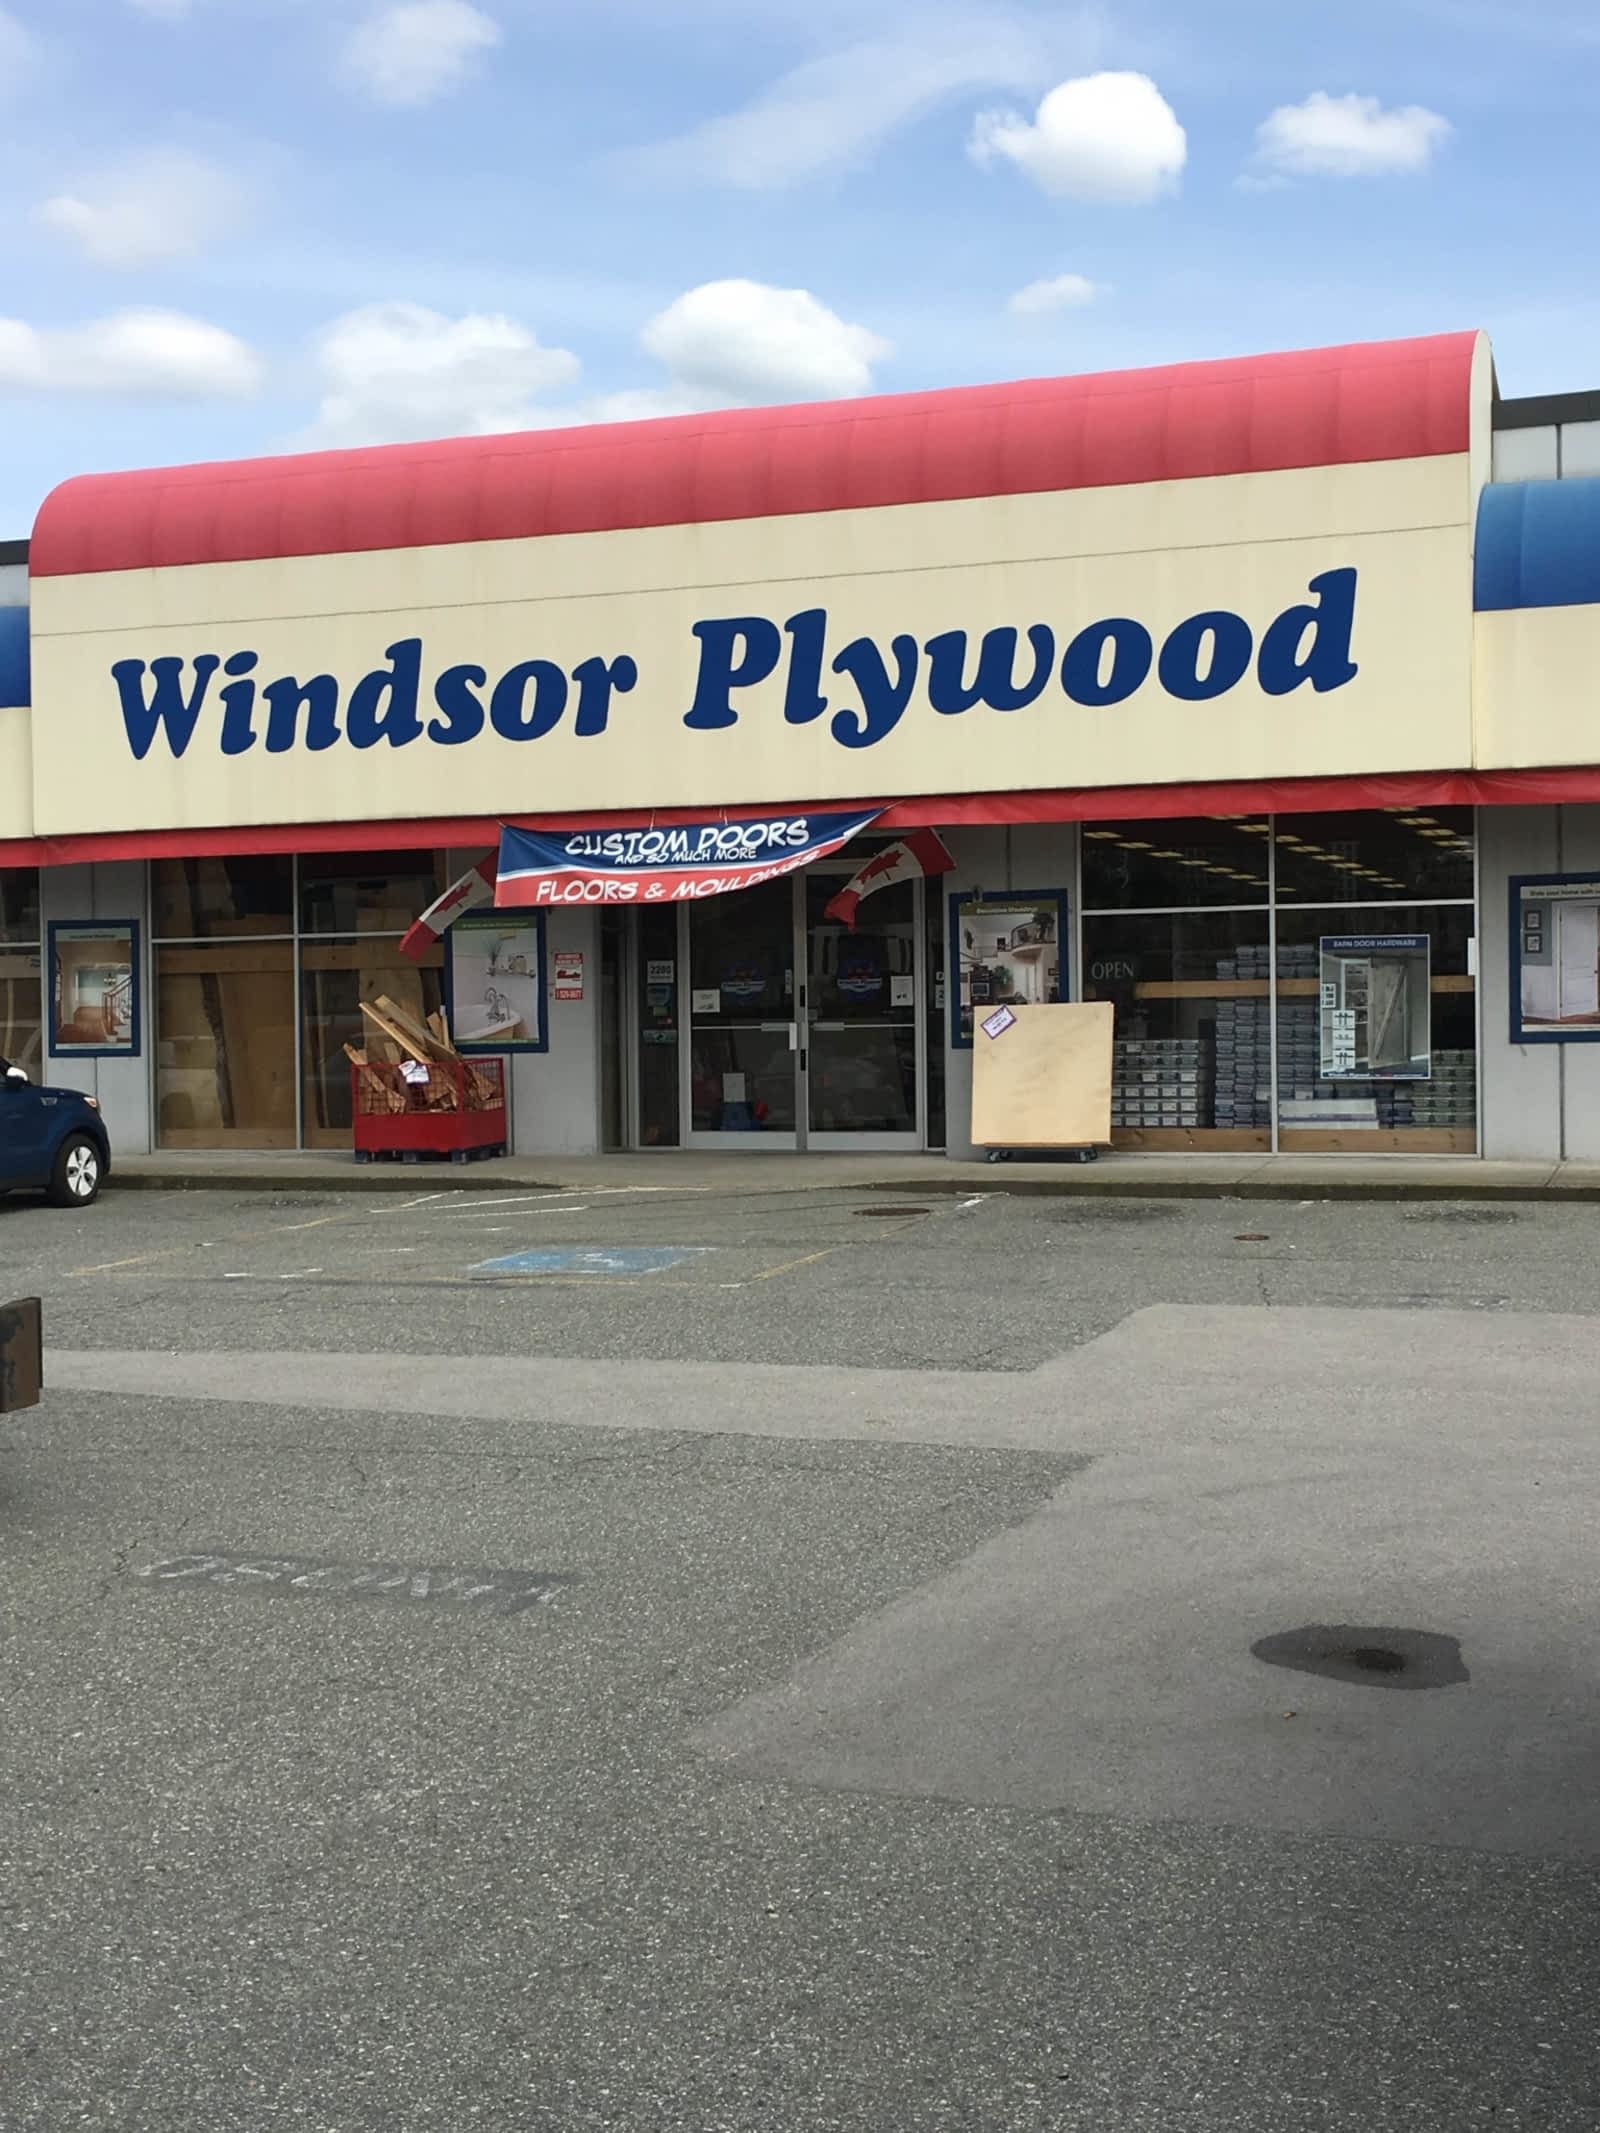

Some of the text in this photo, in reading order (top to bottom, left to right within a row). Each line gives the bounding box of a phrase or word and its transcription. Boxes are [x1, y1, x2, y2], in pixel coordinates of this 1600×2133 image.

[112, 567, 1359, 760] Windsor Plywood
[564, 819, 810, 856] CUSTOM DOORS
[614, 846, 758, 865] AND SO MUCH MORE
[536, 849, 821, 902] FLOORS & MOULDINGS
[1353, 940, 1376, 948] DOOR
[1376, 939, 1417, 947] HARDWARE
[1091, 961, 1134, 980] OPEN
